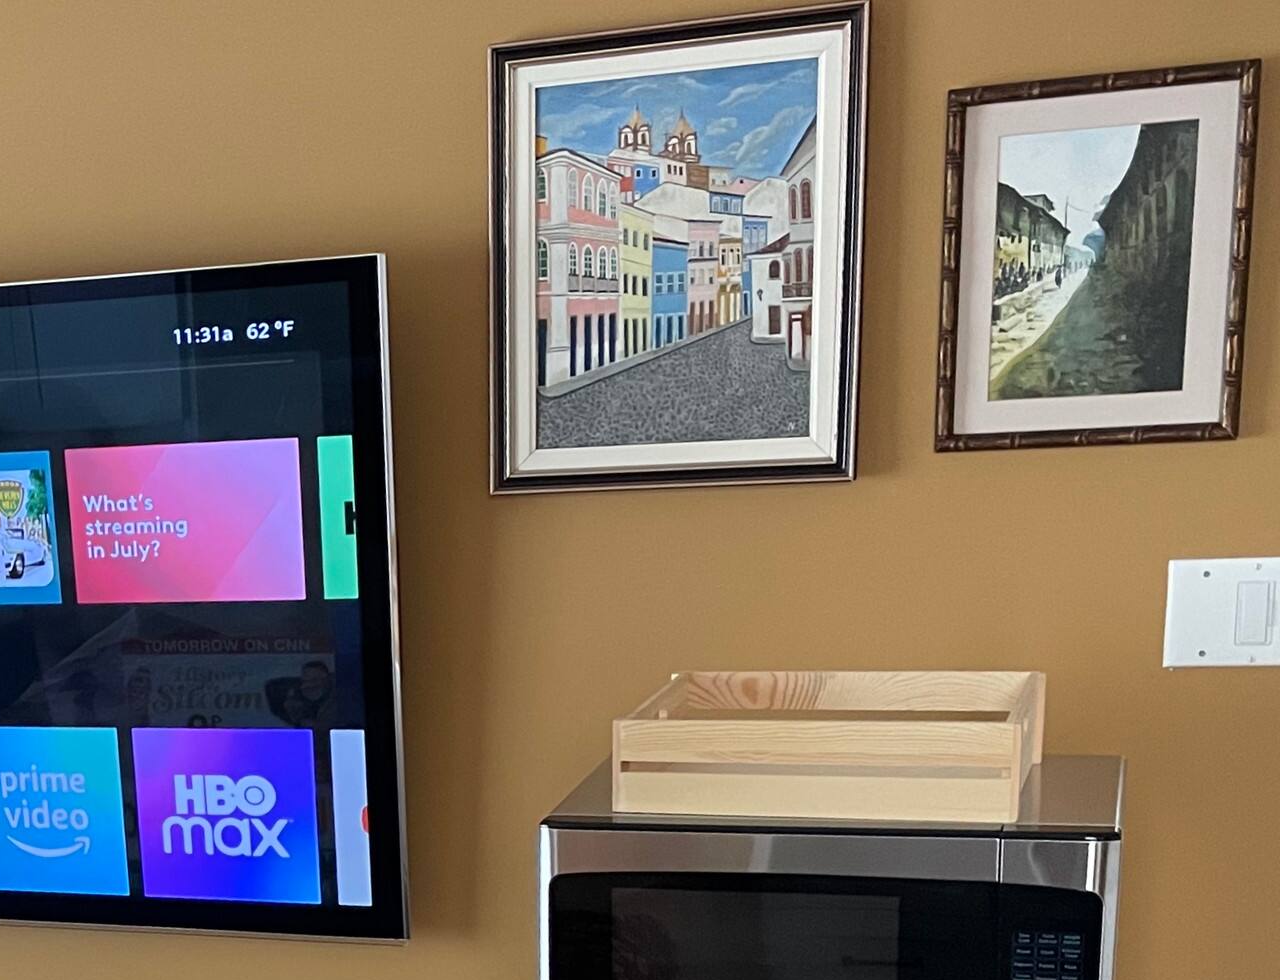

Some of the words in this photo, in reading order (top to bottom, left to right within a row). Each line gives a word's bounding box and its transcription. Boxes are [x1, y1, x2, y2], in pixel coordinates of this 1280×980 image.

[173, 326, 234, 345] 11:31a
[246, 322, 271, 340] 62
[82, 493, 154, 513] What's
[85, 516, 188, 538] streaming
[86, 540, 105, 559] in
[110, 540, 160, 562] July?
[144, 638, 239, 652] TOMORROW
[245, 638, 269, 652] ON
[274, 638, 311, 652] CNN
[0, 764, 86, 799] prime
[173, 774, 277, 817] HBO
[3, 799, 89, 830] video
[161, 815, 291, 858] max
